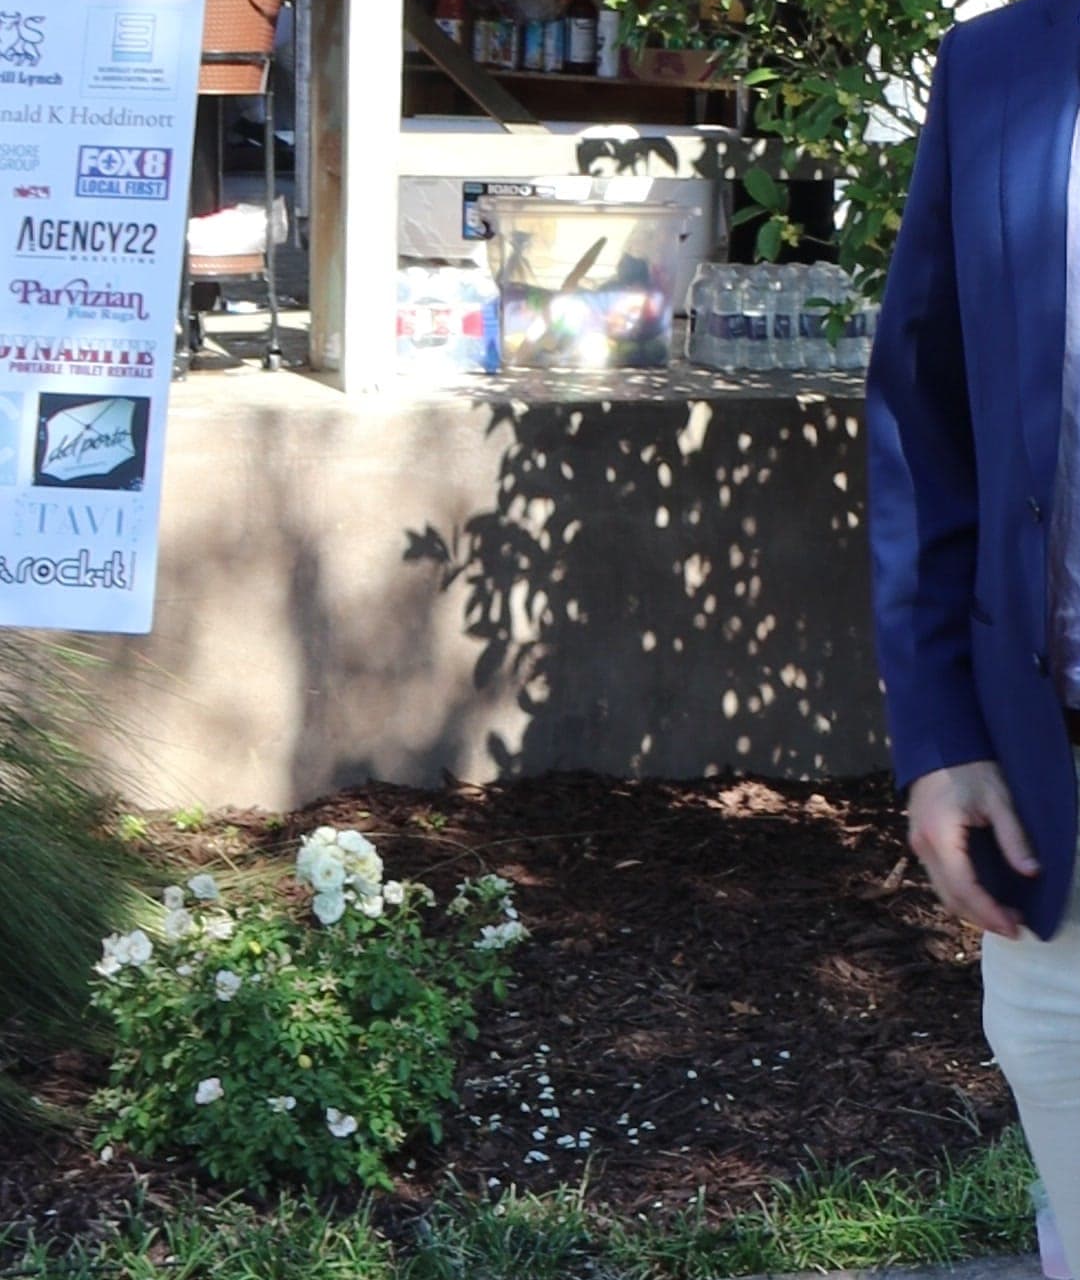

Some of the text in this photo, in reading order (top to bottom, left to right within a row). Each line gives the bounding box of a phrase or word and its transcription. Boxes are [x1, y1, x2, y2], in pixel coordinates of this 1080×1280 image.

[0, 71, 63, 87] ill Lynch
[49, 106, 64, 125] K
[69, 106, 175, 128] Hoddinott
[0, 158, 40, 172] GROUP
[82, 179, 163, 196] LOCAL FIRST
[16, 216, 158, 255] AGENCY22
[9, 278, 149, 320] Parvizian
[8, 361, 154, 379] PORTABLE TOILET RENTALS
[16, 548, 127, 589] rock-it
